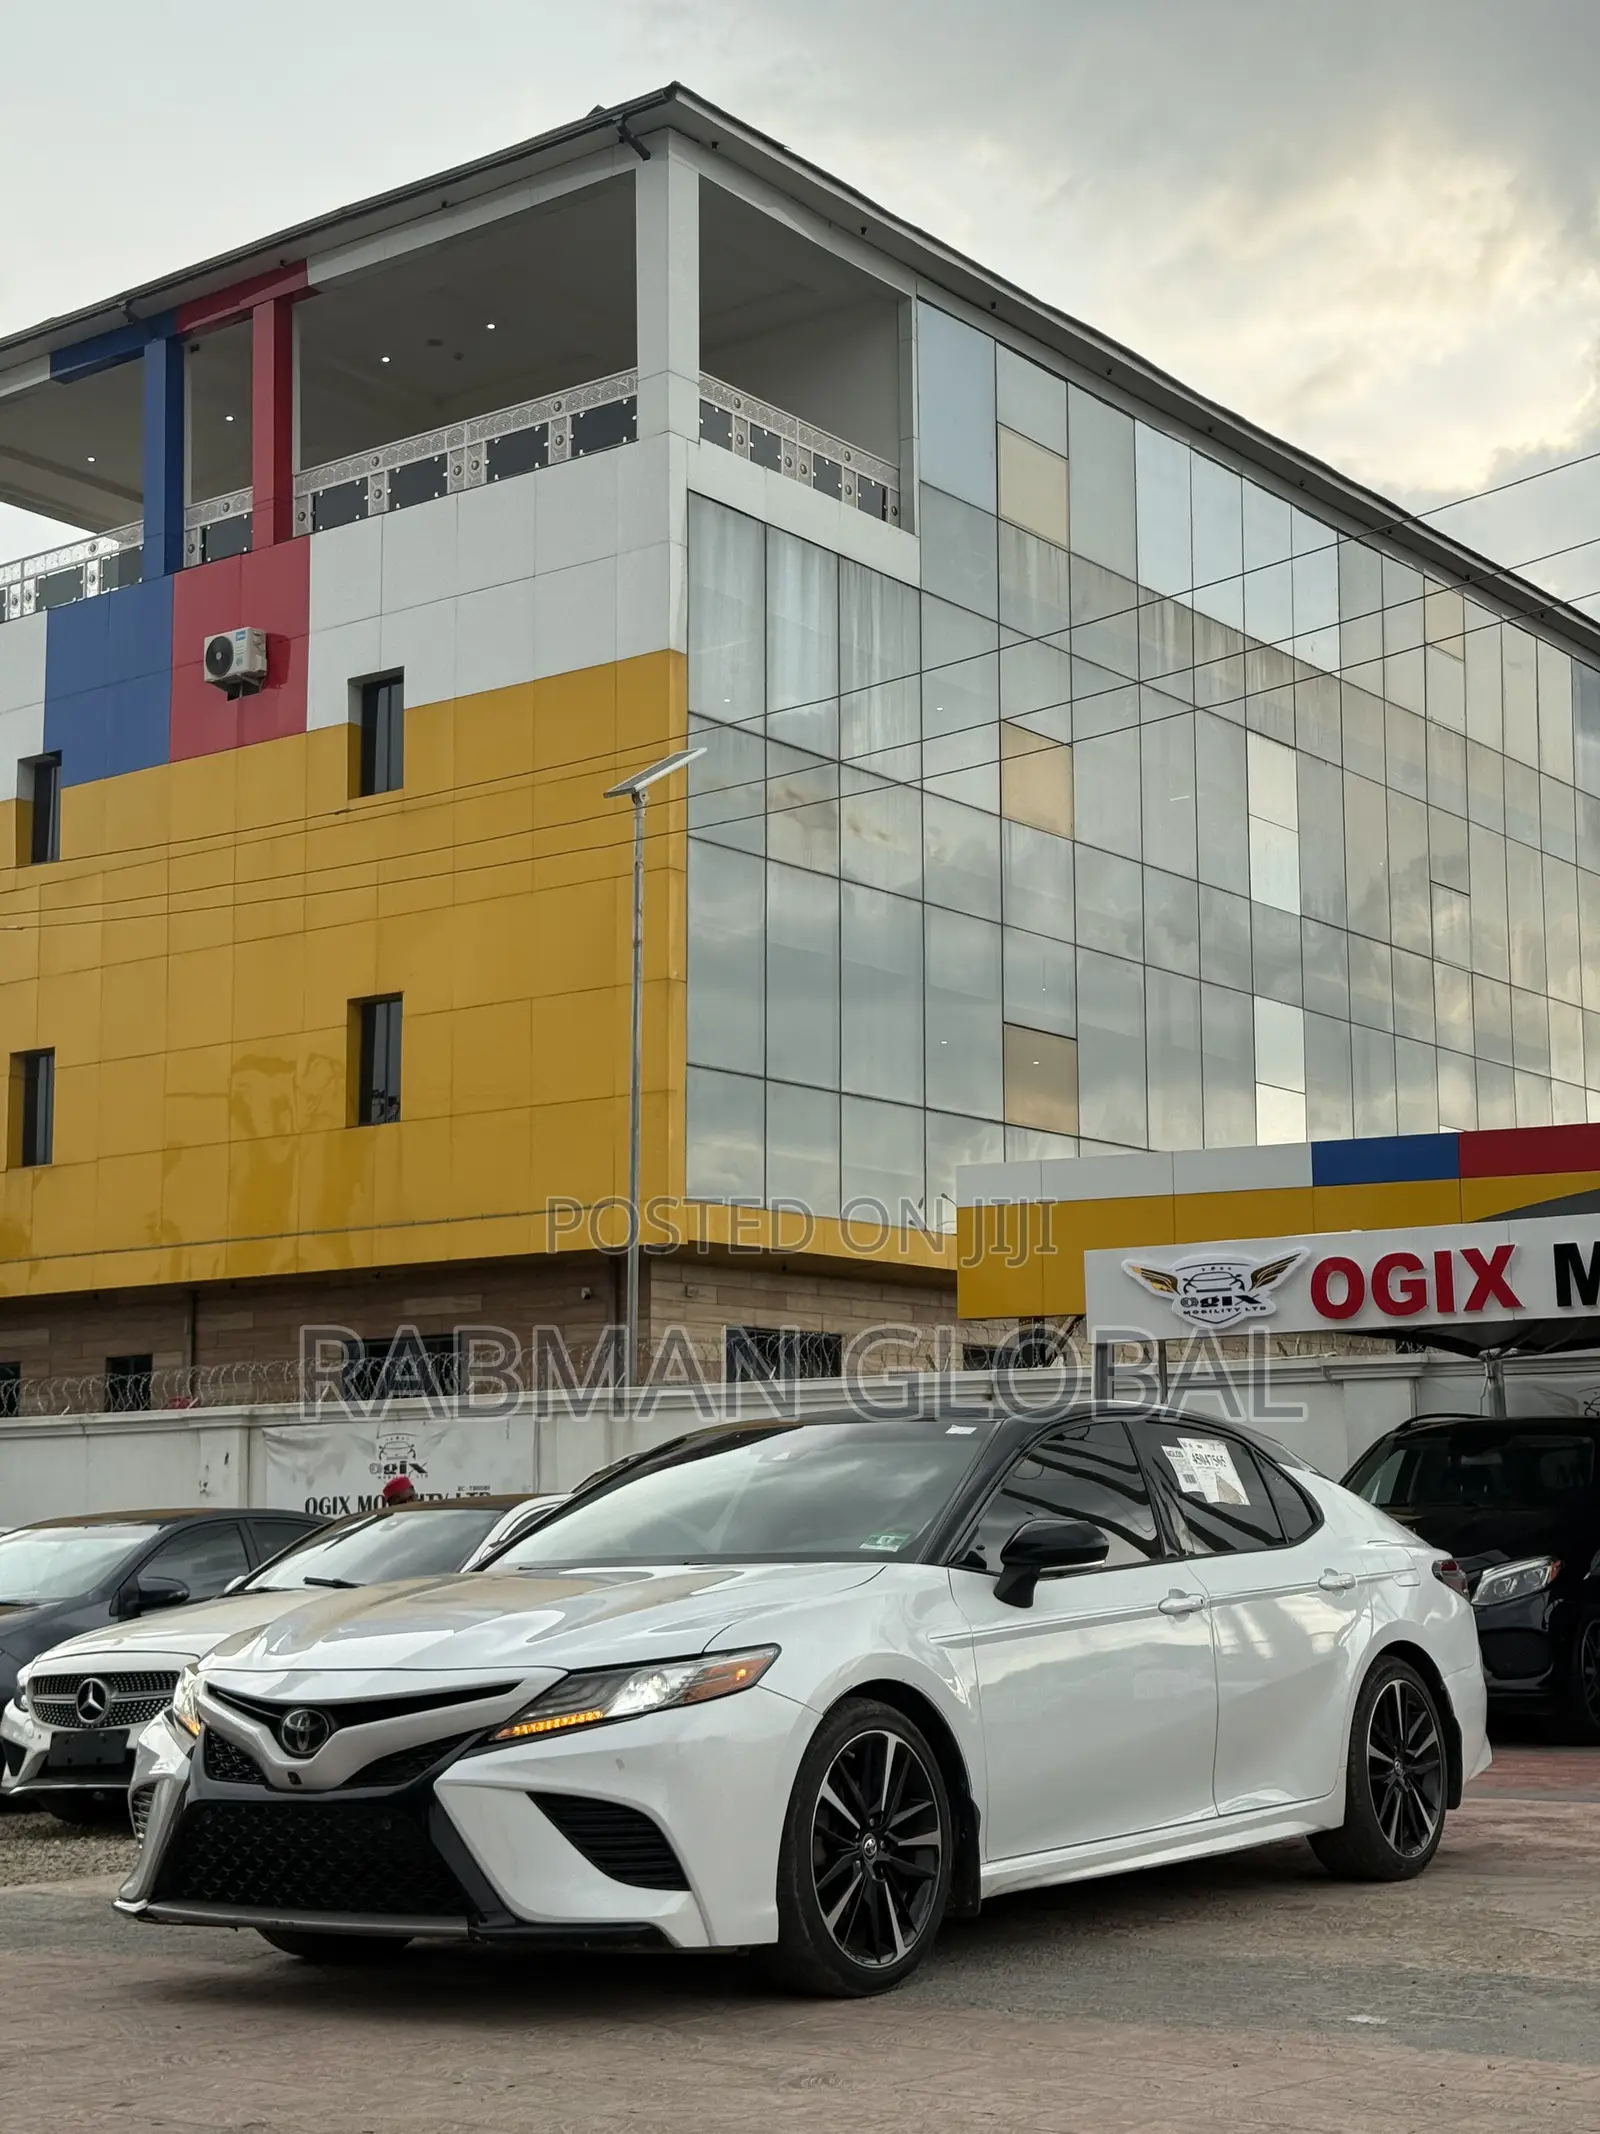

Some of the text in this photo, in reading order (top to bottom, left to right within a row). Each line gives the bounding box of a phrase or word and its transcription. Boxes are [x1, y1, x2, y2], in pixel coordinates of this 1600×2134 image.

[1311, 1243, 1526, 1320] OGIX
[1183, 1307, 1241, 1315] MOBILITY
[305, 1495, 351, 1515] OGIX
